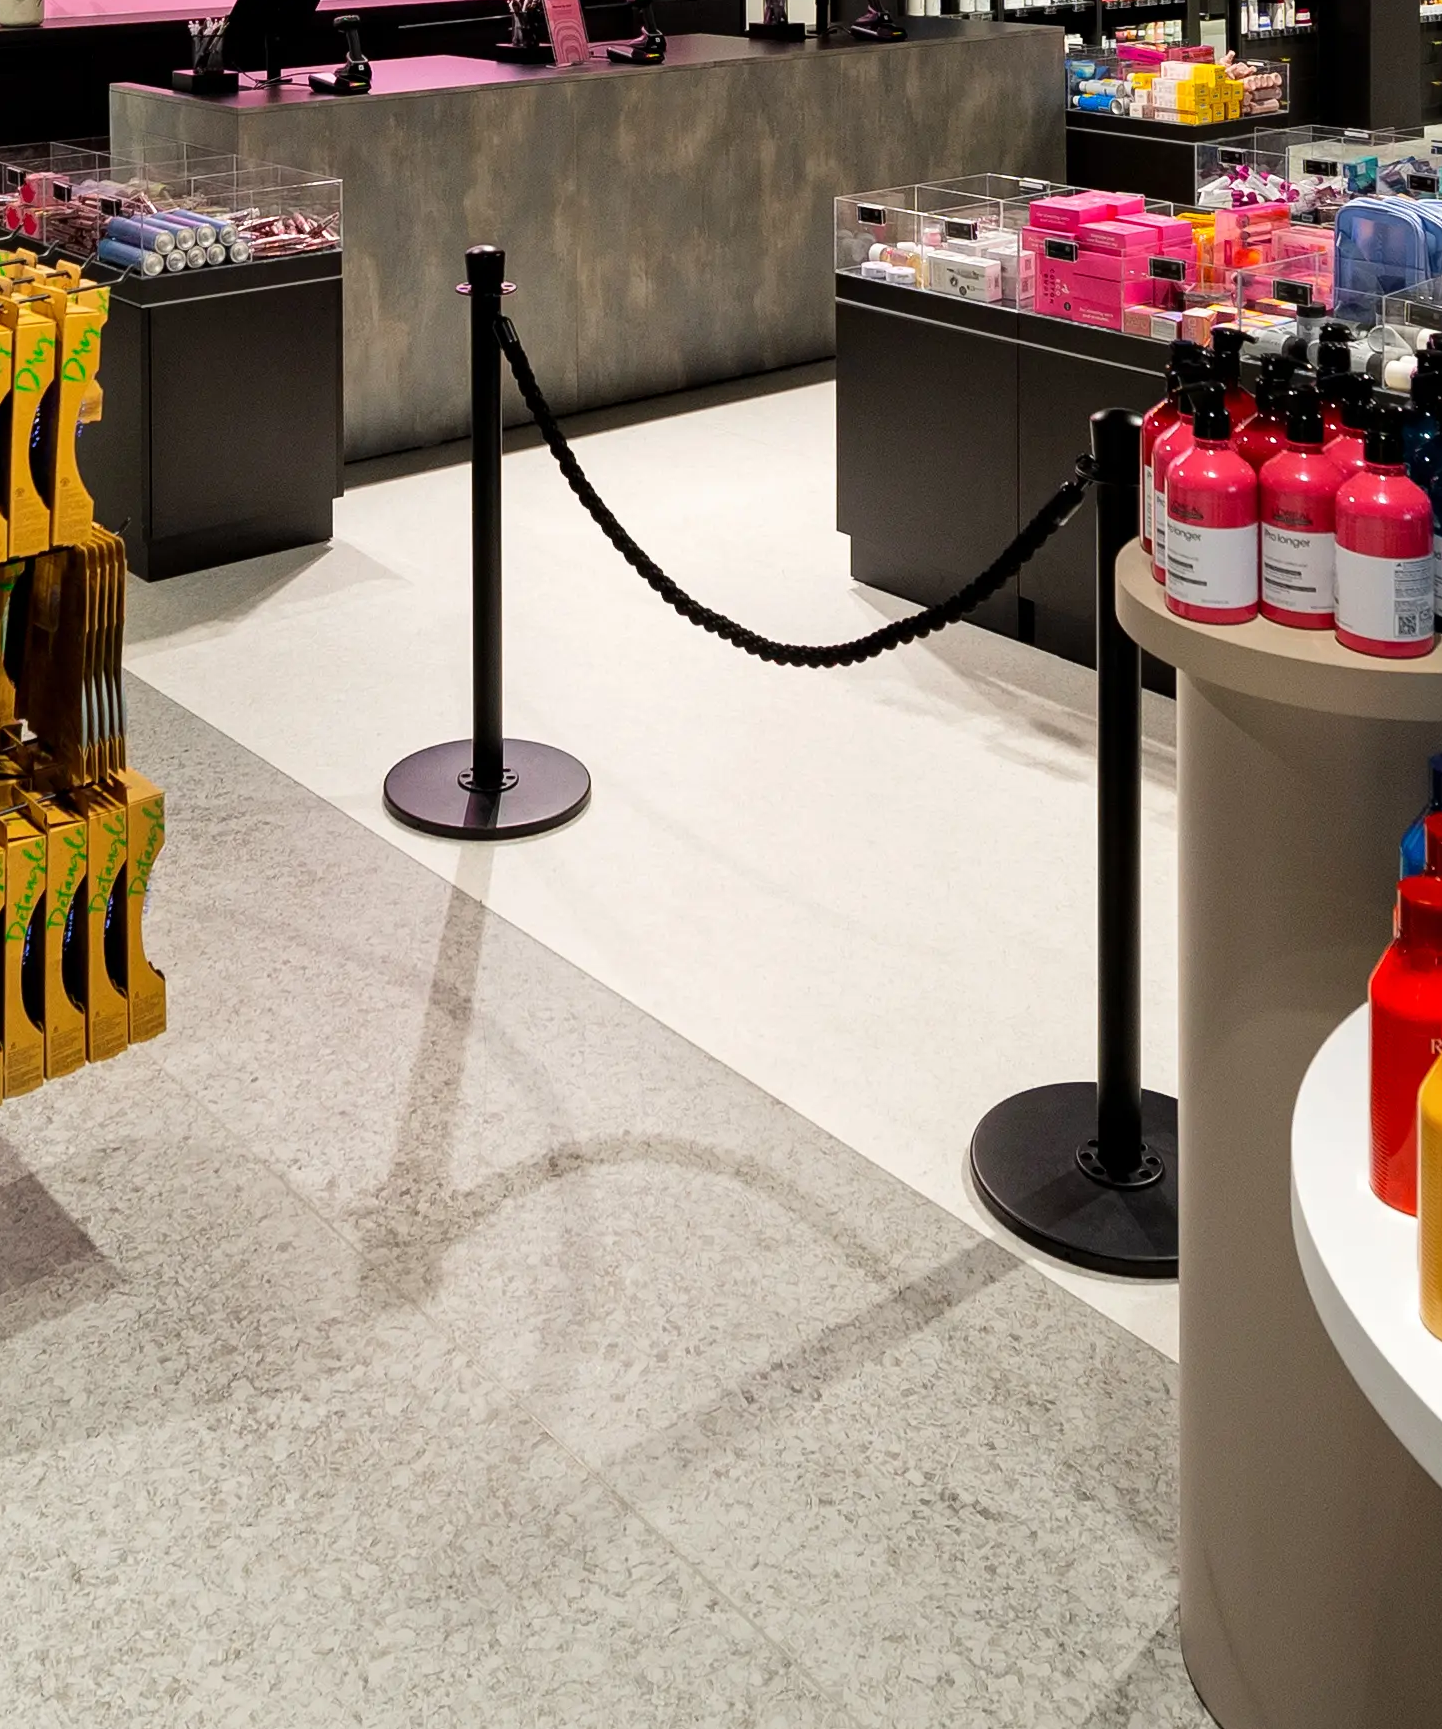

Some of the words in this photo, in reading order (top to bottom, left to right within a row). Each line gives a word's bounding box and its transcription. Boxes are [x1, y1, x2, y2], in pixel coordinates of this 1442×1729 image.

[15, 334, 56, 393] Dry
[63, 326, 101, 382] Dry
[1277, 532, 1311, 549] longer
[6, 840, 47, 943] Detangle
[47, 827, 87, 930] Detangle
[88, 813, 128, 914] Detangle
[128, 800, 166, 897] Detangle
